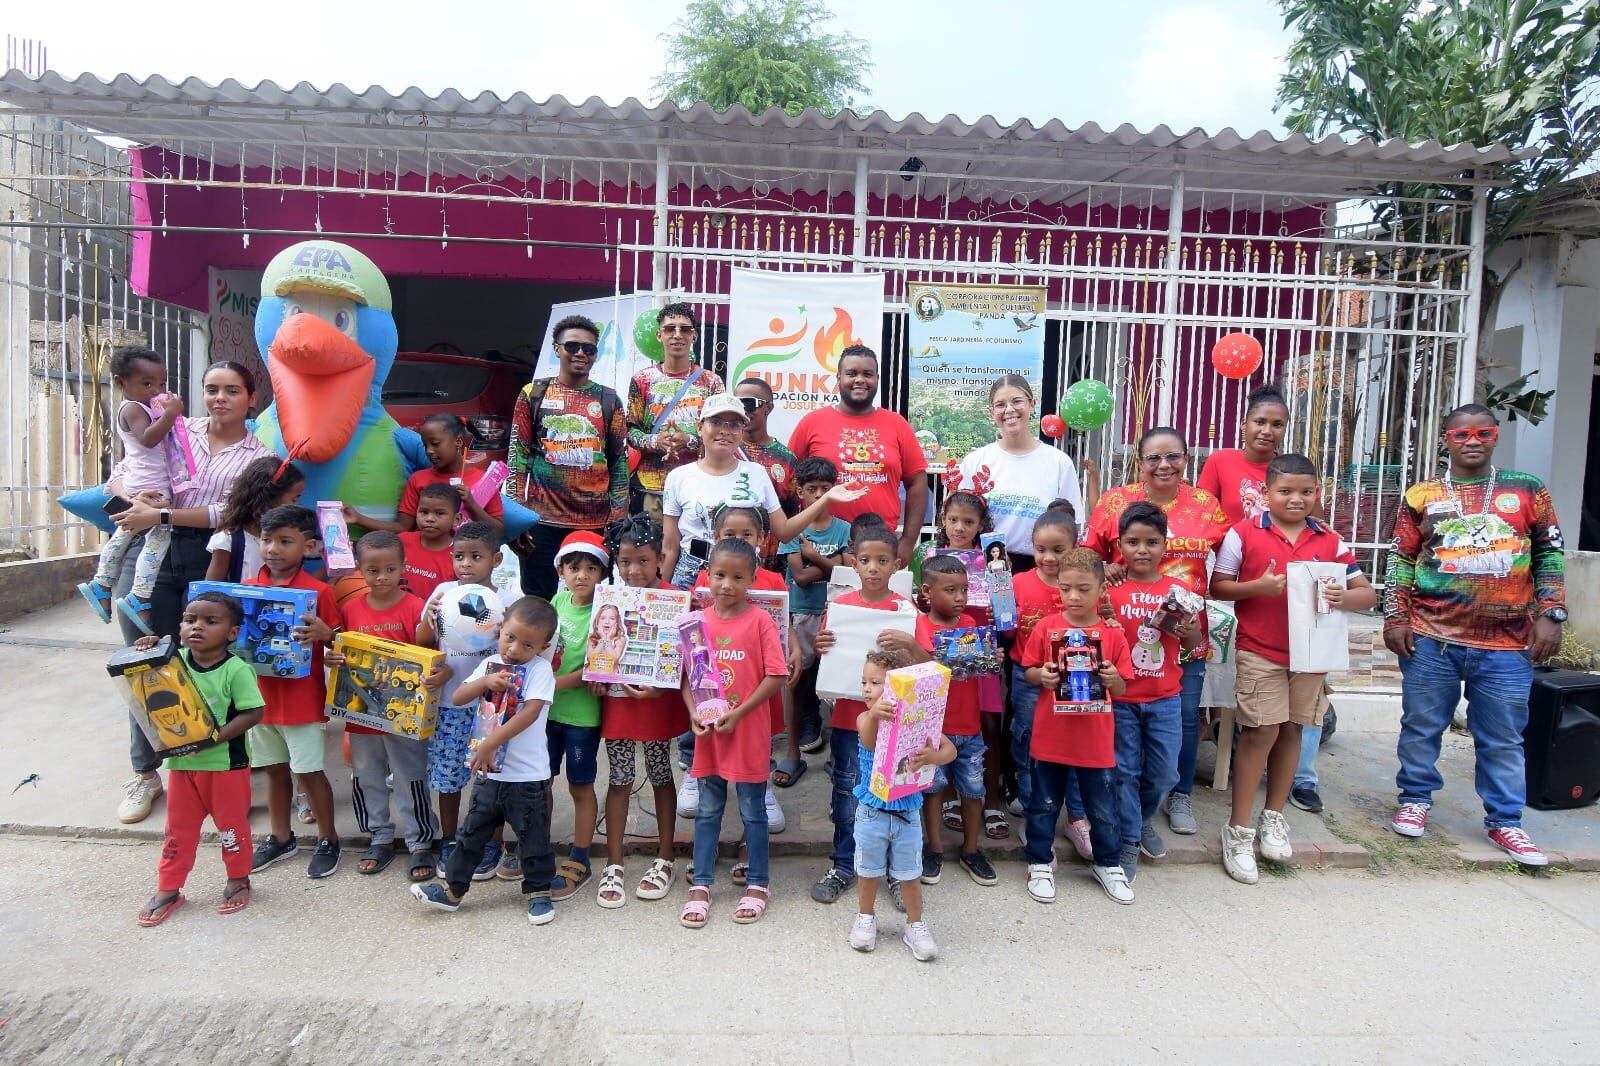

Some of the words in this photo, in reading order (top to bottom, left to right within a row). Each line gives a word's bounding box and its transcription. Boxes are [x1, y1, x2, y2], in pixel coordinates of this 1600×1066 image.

[293, 246, 352, 273] EPA
[952, 366, 962, 374] se
[965, 366, 1012, 375] transforma
[745, 371, 840, 394] UNK
[773, 391, 818, 402] DACIÓN
[823, 394, 839, 403] KA
[713, 649, 746, 661] VIDAD
[331, 707, 347, 719] DIY
